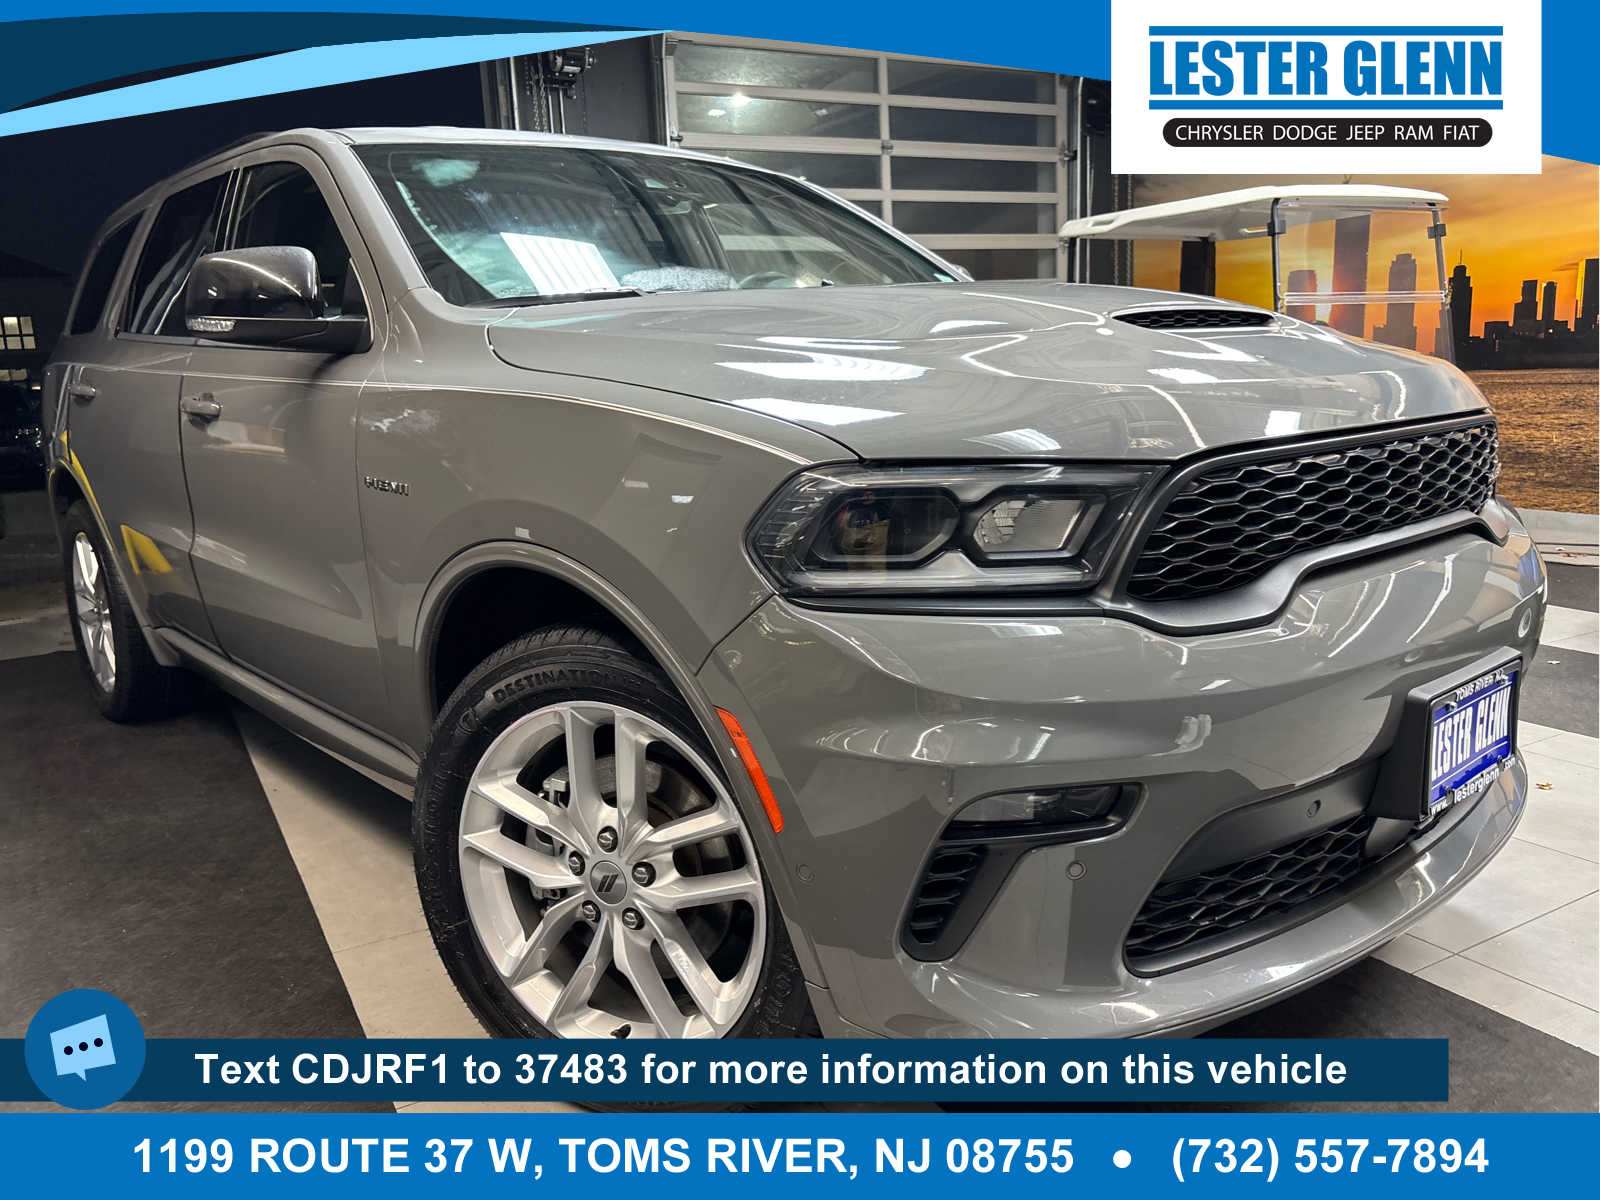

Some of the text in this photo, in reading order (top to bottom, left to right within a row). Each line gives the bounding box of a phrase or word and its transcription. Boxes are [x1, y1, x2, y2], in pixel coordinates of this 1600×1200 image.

[491, 668, 618, 702] DESTINATION
[1456, 683, 1474, 702] TOMS
[1431, 685, 1512, 782] LESTER GLENN
